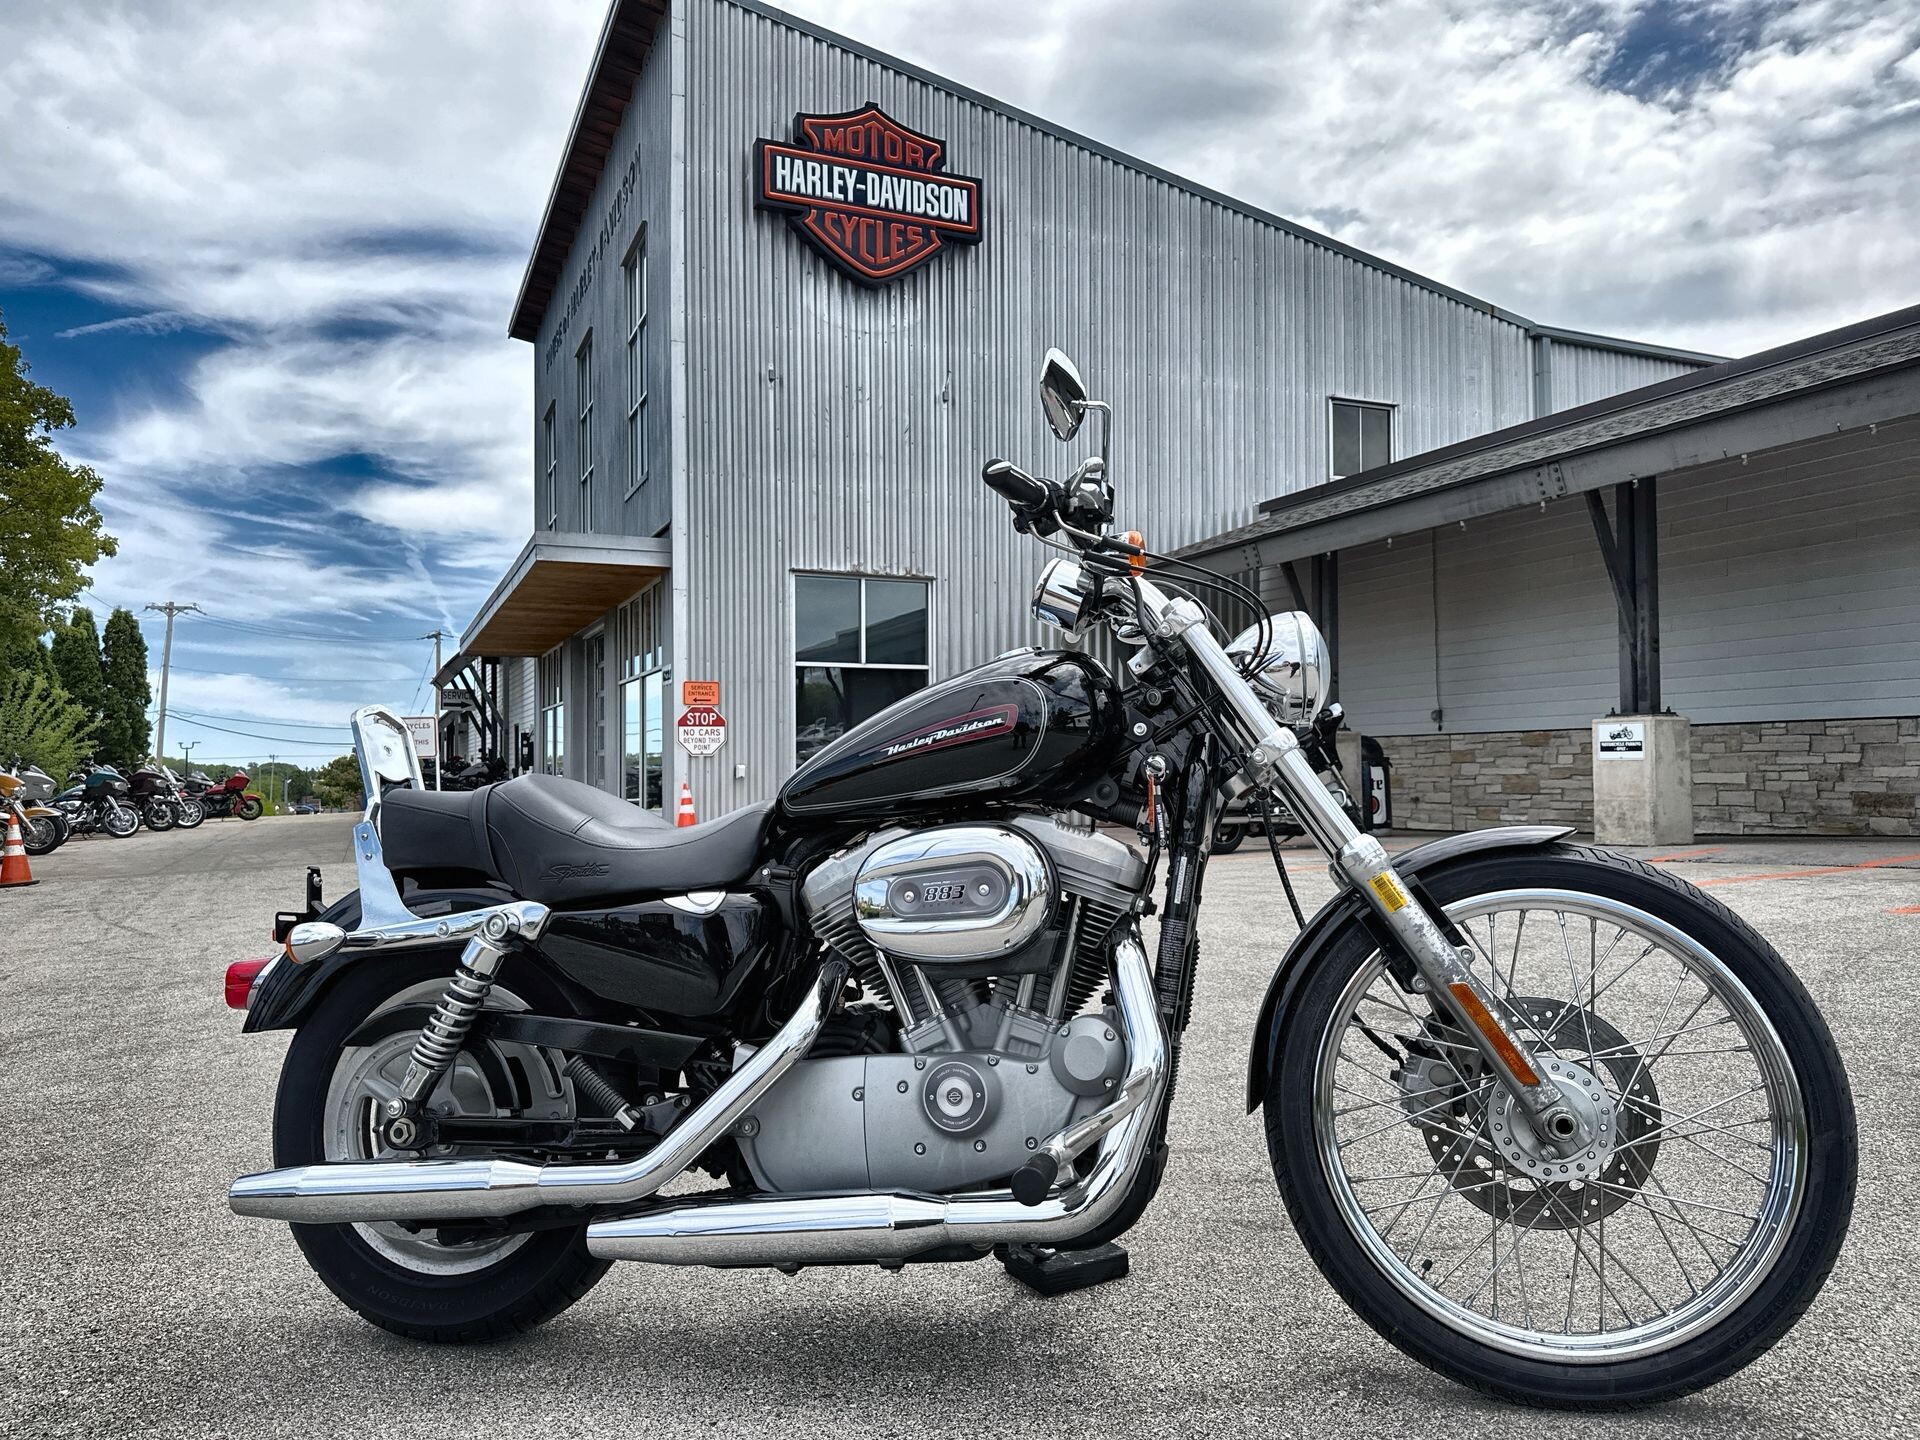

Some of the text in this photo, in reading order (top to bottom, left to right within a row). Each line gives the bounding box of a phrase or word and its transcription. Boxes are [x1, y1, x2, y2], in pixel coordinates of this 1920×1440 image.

[823, 120, 924, 168] MOTOR
[775, 155, 968, 222] HARLEY-DAVIDSON
[823, 211, 923, 265] CYCLES
[683, 728, 721, 736] NO CARS
[686, 712, 717, 725] STOP
[880, 717, 1005, 756] Harley-Davidson
[923, 883, 966, 902] 883
